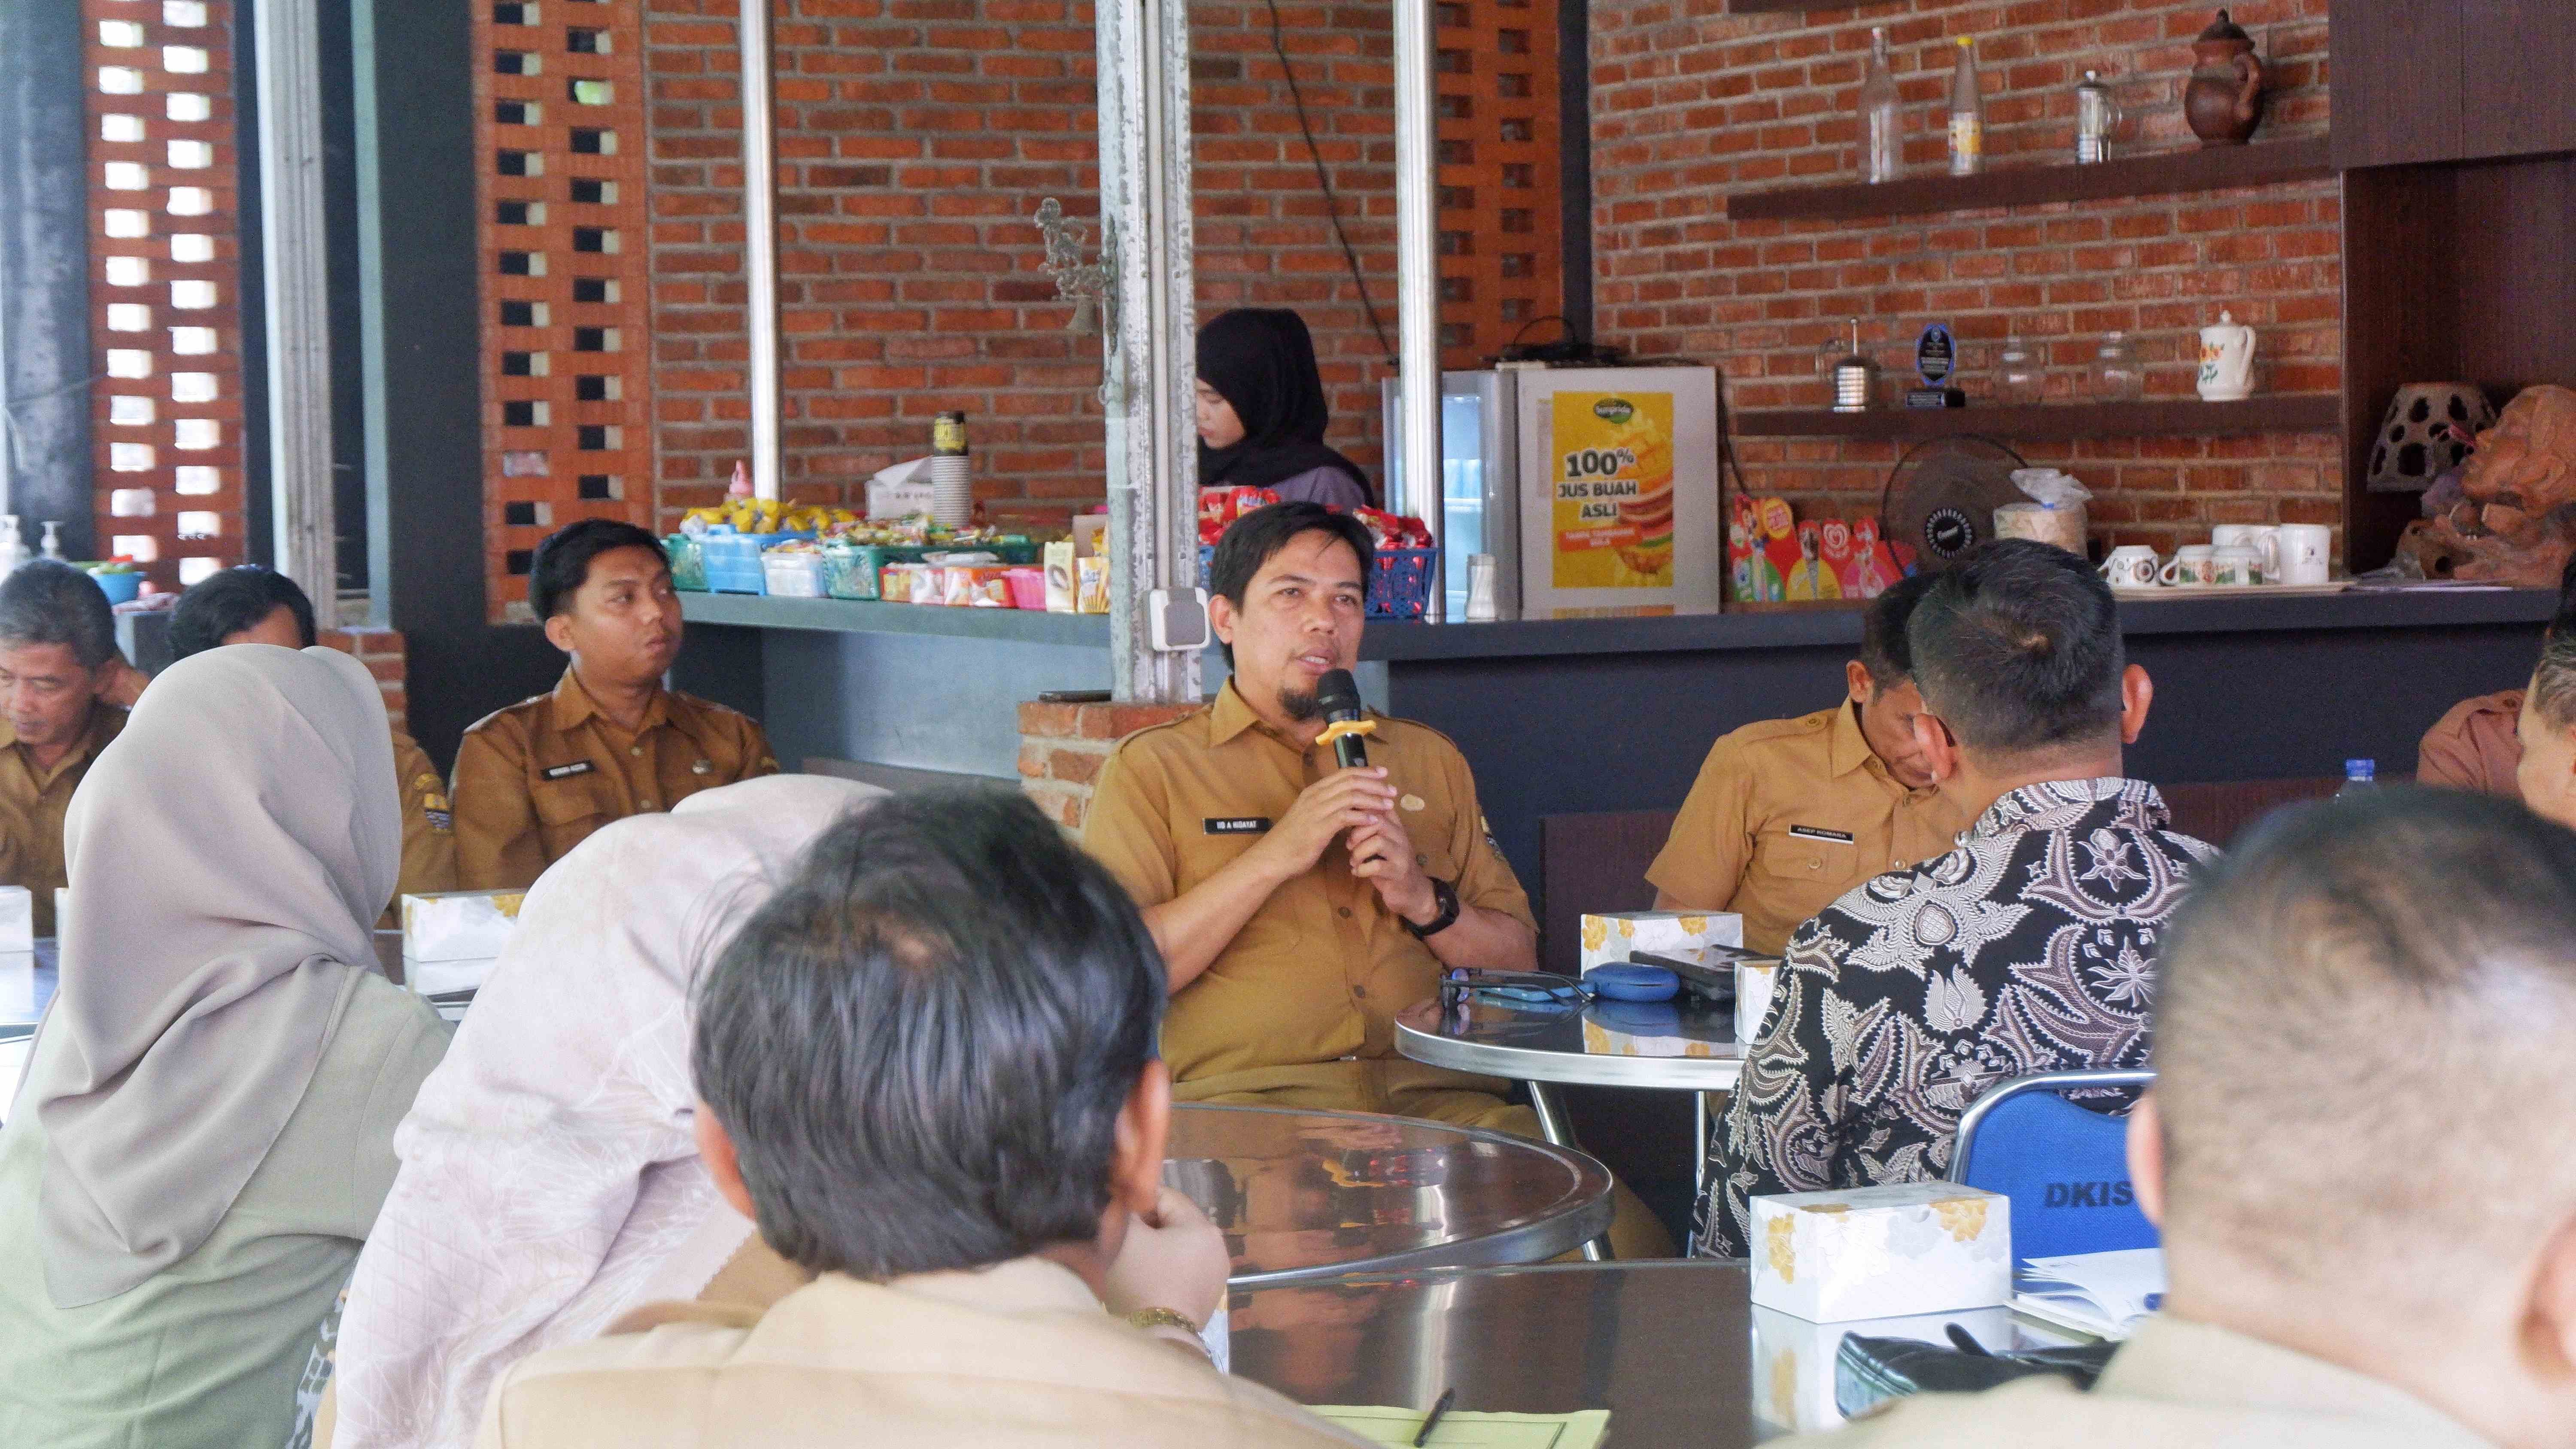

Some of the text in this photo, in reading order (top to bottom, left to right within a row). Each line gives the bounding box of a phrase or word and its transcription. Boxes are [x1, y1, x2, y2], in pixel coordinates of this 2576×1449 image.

[1567, 448, 1634, 477] 100%
[1558, 481, 1637, 497] JUS BUAH
[1582, 503, 1617, 518] ASLI
[2044, 1181, 2133, 1207] DKIS
